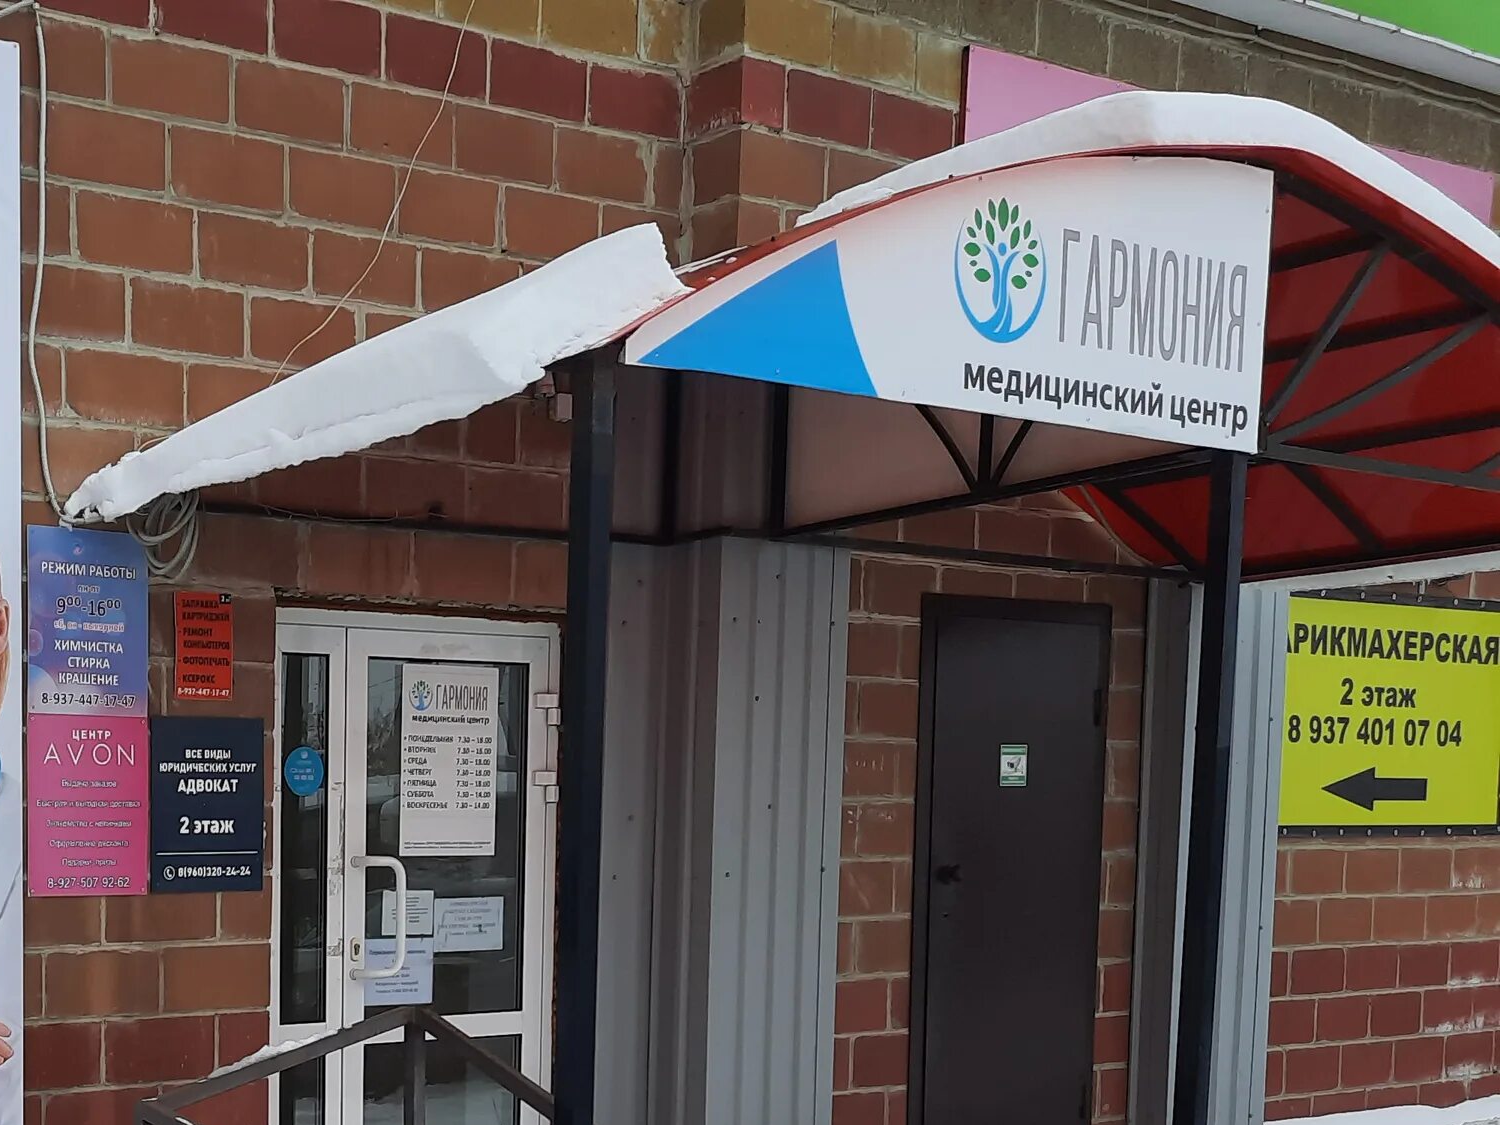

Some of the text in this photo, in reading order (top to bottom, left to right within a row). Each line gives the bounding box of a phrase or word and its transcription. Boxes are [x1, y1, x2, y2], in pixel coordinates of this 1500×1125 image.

[1059, 228, 1248, 374] ГАРМОНИЯ
[963, 362, 1248, 437] медицинский центр
[41, 561, 136, 580] РЕЖИМ РАБОТЫ
[54, 639, 124, 654] ХИМЧИСТКА
[1287, 622, 1499, 665] РИКМАХЕРСКАЯ
[68, 656, 110, 669] СТИРКА
[58, 672, 119, 686] КРАШЕНИЕ
[41, 692, 135, 707] 8-937-447-17-47
[435, 684, 489, 711] ГАРМОНИЯ
[1340, 677, 1416, 708] 2 этаж
[72, 730, 112, 741] ЦЕНТР
[1288, 714, 1462, 747] 8 937 401 07 04
[43, 744, 135, 766] AVON
[185, 749, 231, 760] ВСЕ ВИДЫ
[160, 762, 257, 773] ЮРИДИЧЕСКИХ УСЛУГ
[178, 779, 238, 795] АДВОКАТ
[180, 816, 235, 834] 2 этаж
[177, 866, 251, 878] 8(960)320-24-24
